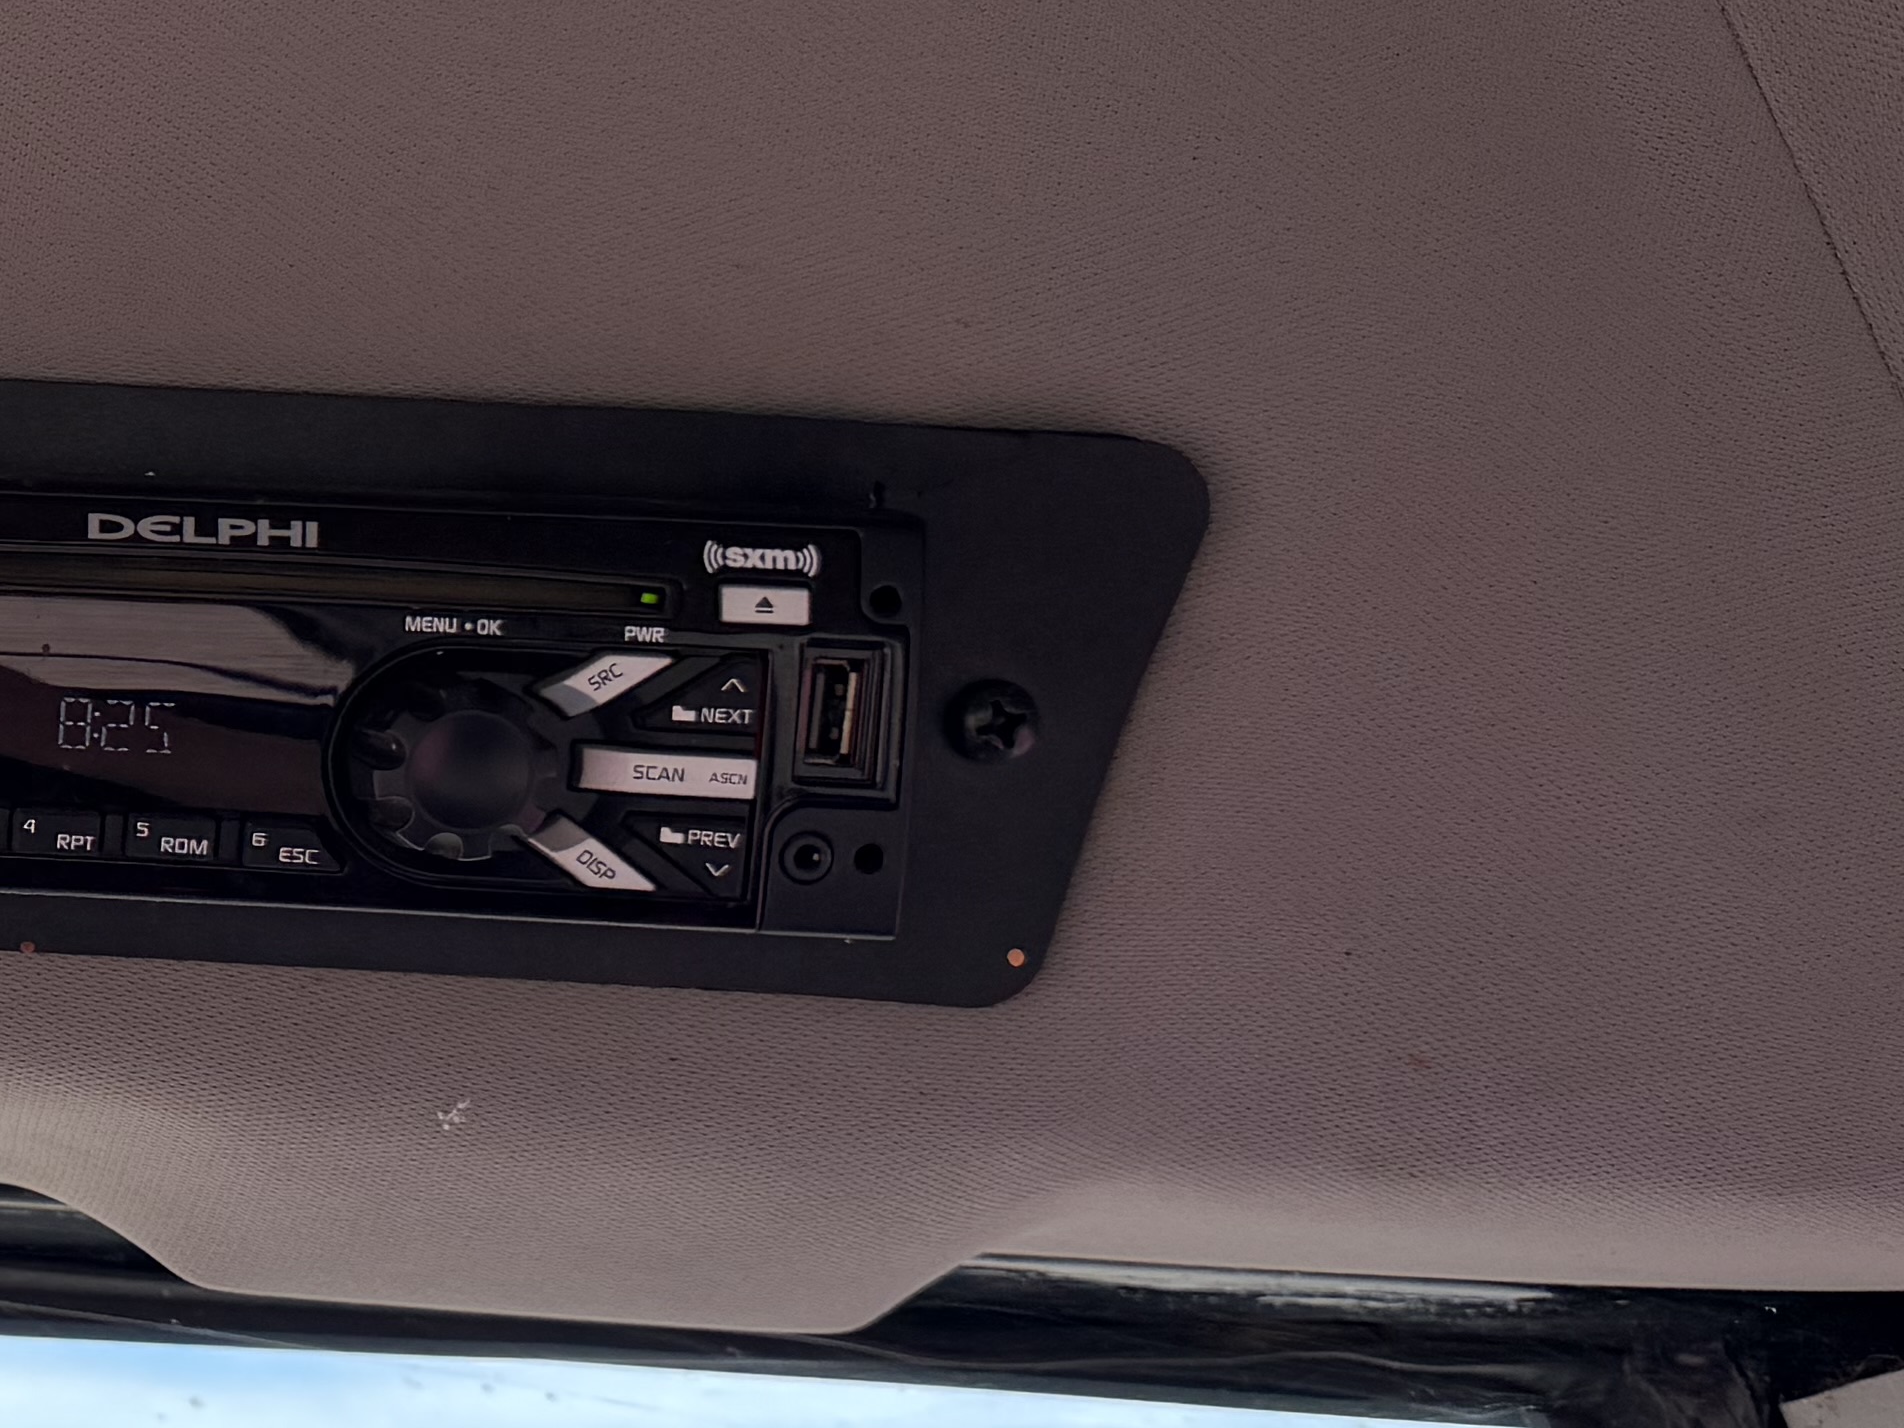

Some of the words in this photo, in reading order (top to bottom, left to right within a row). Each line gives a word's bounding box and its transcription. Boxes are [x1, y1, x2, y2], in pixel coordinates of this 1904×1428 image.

[87, 512, 319, 548] DELPHI
[404, 615, 457, 633] MENU
[477, 618, 503, 636] OK
[624, 626, 665, 643] PWR
[587, 663, 624, 691] SRC
[58, 696, 176, 754] 8:25
[700, 707, 754, 724] NEXT
[632, 764, 685, 782] SCAN
[709, 772, 748, 785] ASCN
[23, 818, 36, 833] 4
[136, 821, 150, 837] 5
[56, 833, 96, 852] RPT
[160, 836, 208, 856] RDM
[251, 832, 268, 847] 6
[687, 829, 740, 849] PREV
[278, 847, 320, 865] ESC
[576, 849, 617, 881] DISP
